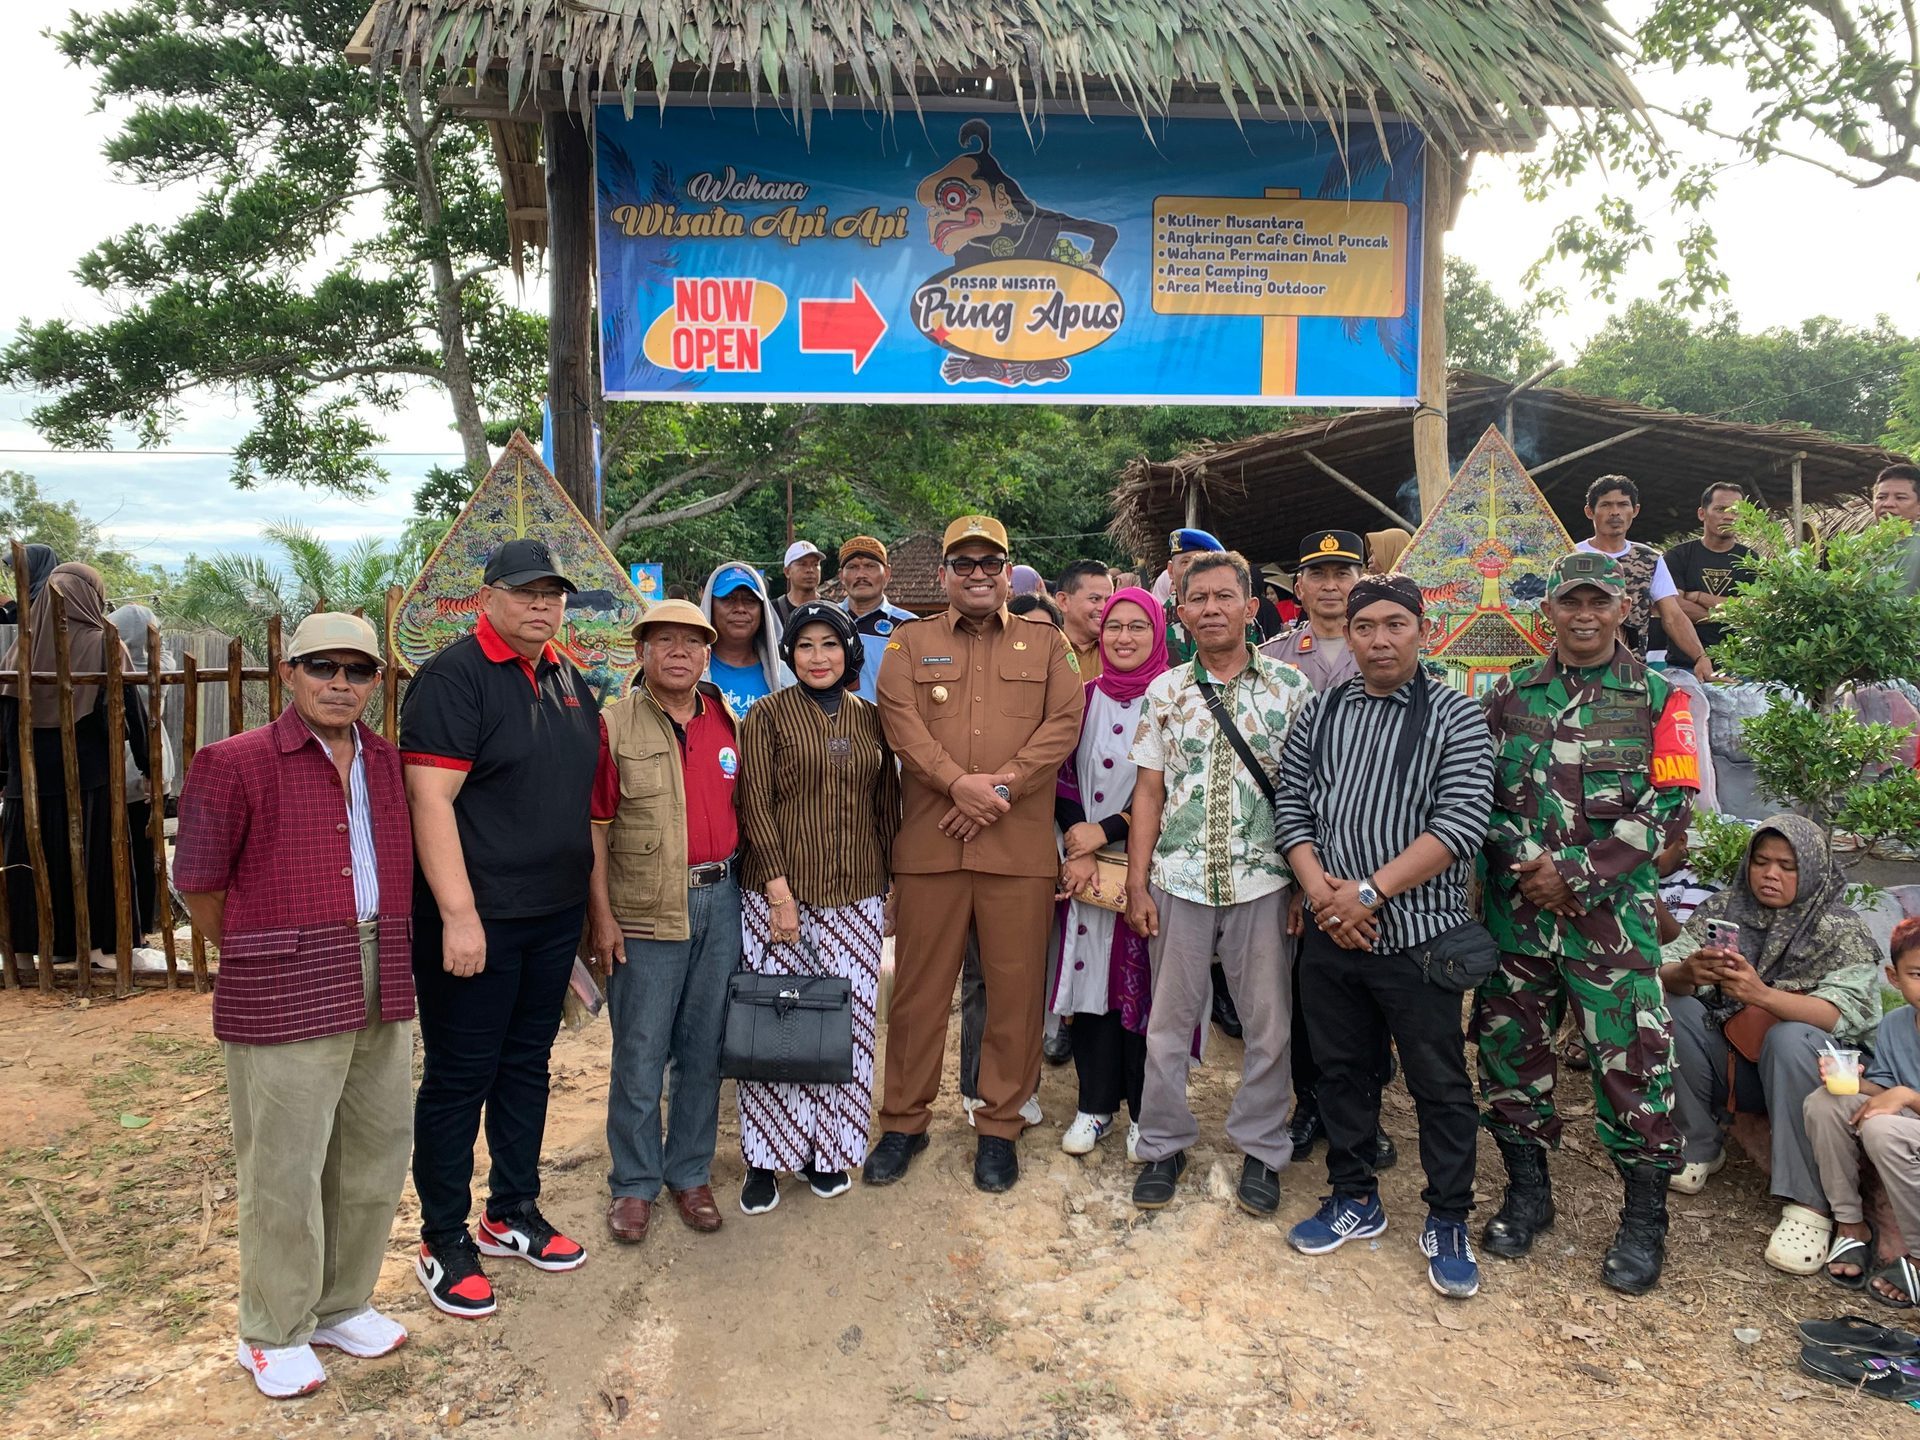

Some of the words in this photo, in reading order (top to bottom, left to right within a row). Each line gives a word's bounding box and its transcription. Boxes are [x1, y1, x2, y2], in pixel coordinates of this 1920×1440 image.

[688, 166, 808, 202] Wahana
[611, 203, 745, 238] Wisata
[750, 206, 828, 246] Api
[832, 207, 909, 247] Api
[1167, 214, 1221, 228] Kuliner
[1226, 215, 1304, 230] Nusantara
[1167, 231, 1252, 247] Angkringan
[1256, 232, 1288, 246] Cafe
[1293, 233, 1333, 247] Cimol
[1338, 235, 1389, 248] Puncak
[1167, 248, 1225, 262] Wahana
[1230, 249, 1308, 263] Permainan
[1312, 250, 1347, 264] Anak
[1166, 264, 1200, 277] Area
[1205, 264, 1268, 281] Camping
[950, 276, 997, 290] PASAR
[1002, 277, 1056, 290] WISATA
[1166, 281, 1200, 294] Area
[1205, 281, 1262, 297] Meeting
[1267, 282, 1327, 296] Outdoor
[674, 279, 755, 322] NOW
[917, 286, 1014, 342] Pring
[1027, 291, 1121, 340] Apus
[672, 328, 760, 371] OPEN
